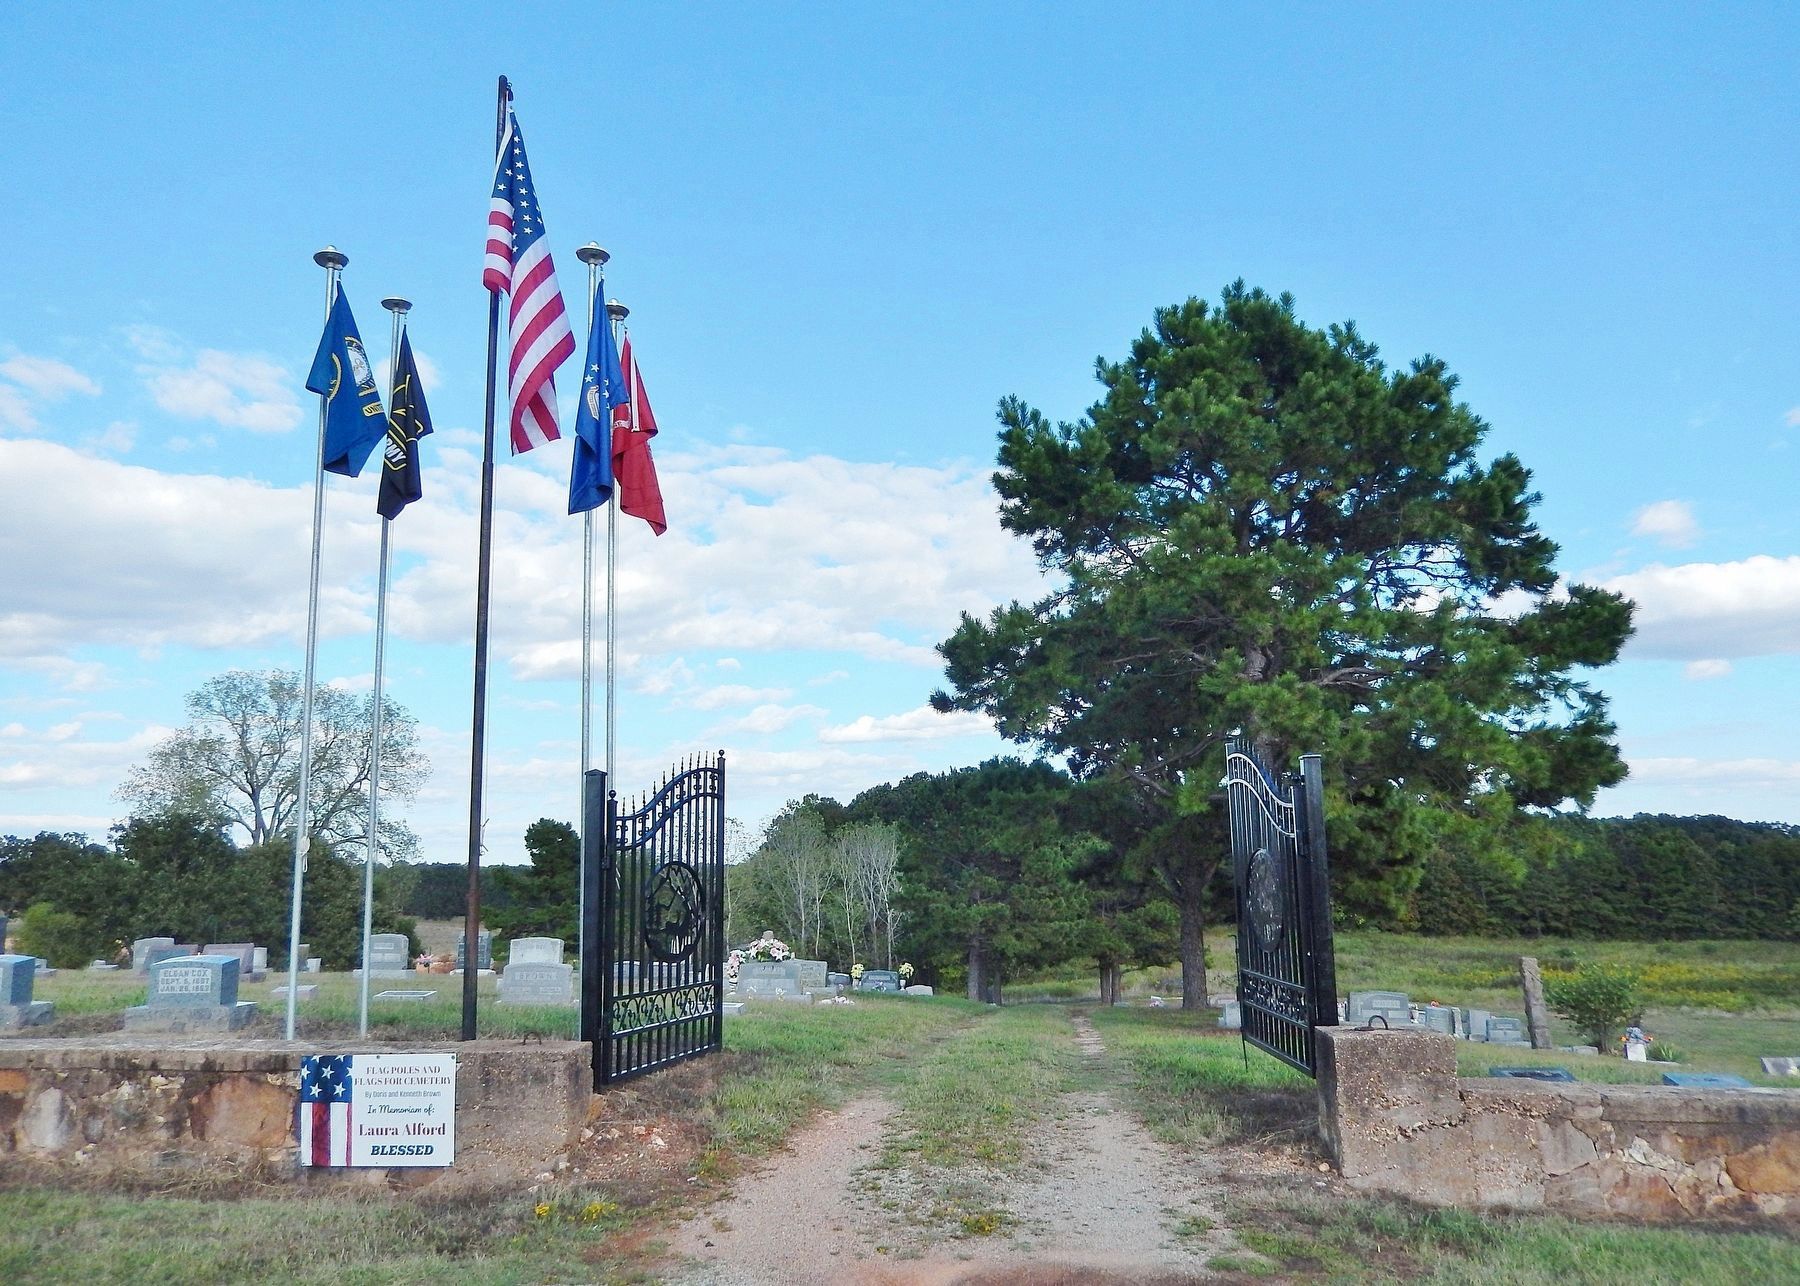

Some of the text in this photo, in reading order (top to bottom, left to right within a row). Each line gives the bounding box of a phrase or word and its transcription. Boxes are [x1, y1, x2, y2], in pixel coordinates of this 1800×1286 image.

[392, 1066, 419, 1074] POLES
[423, 1066, 440, 1074] AND
[384, 1077, 401, 1085] FOR
[404, 1077, 451, 1085] CEMETERY
[368, 1104, 435, 1116] In Memoriam of:
[360, 1123, 446, 1136] Laura Alford
[371, 1145, 433, 1155] BLESSED
